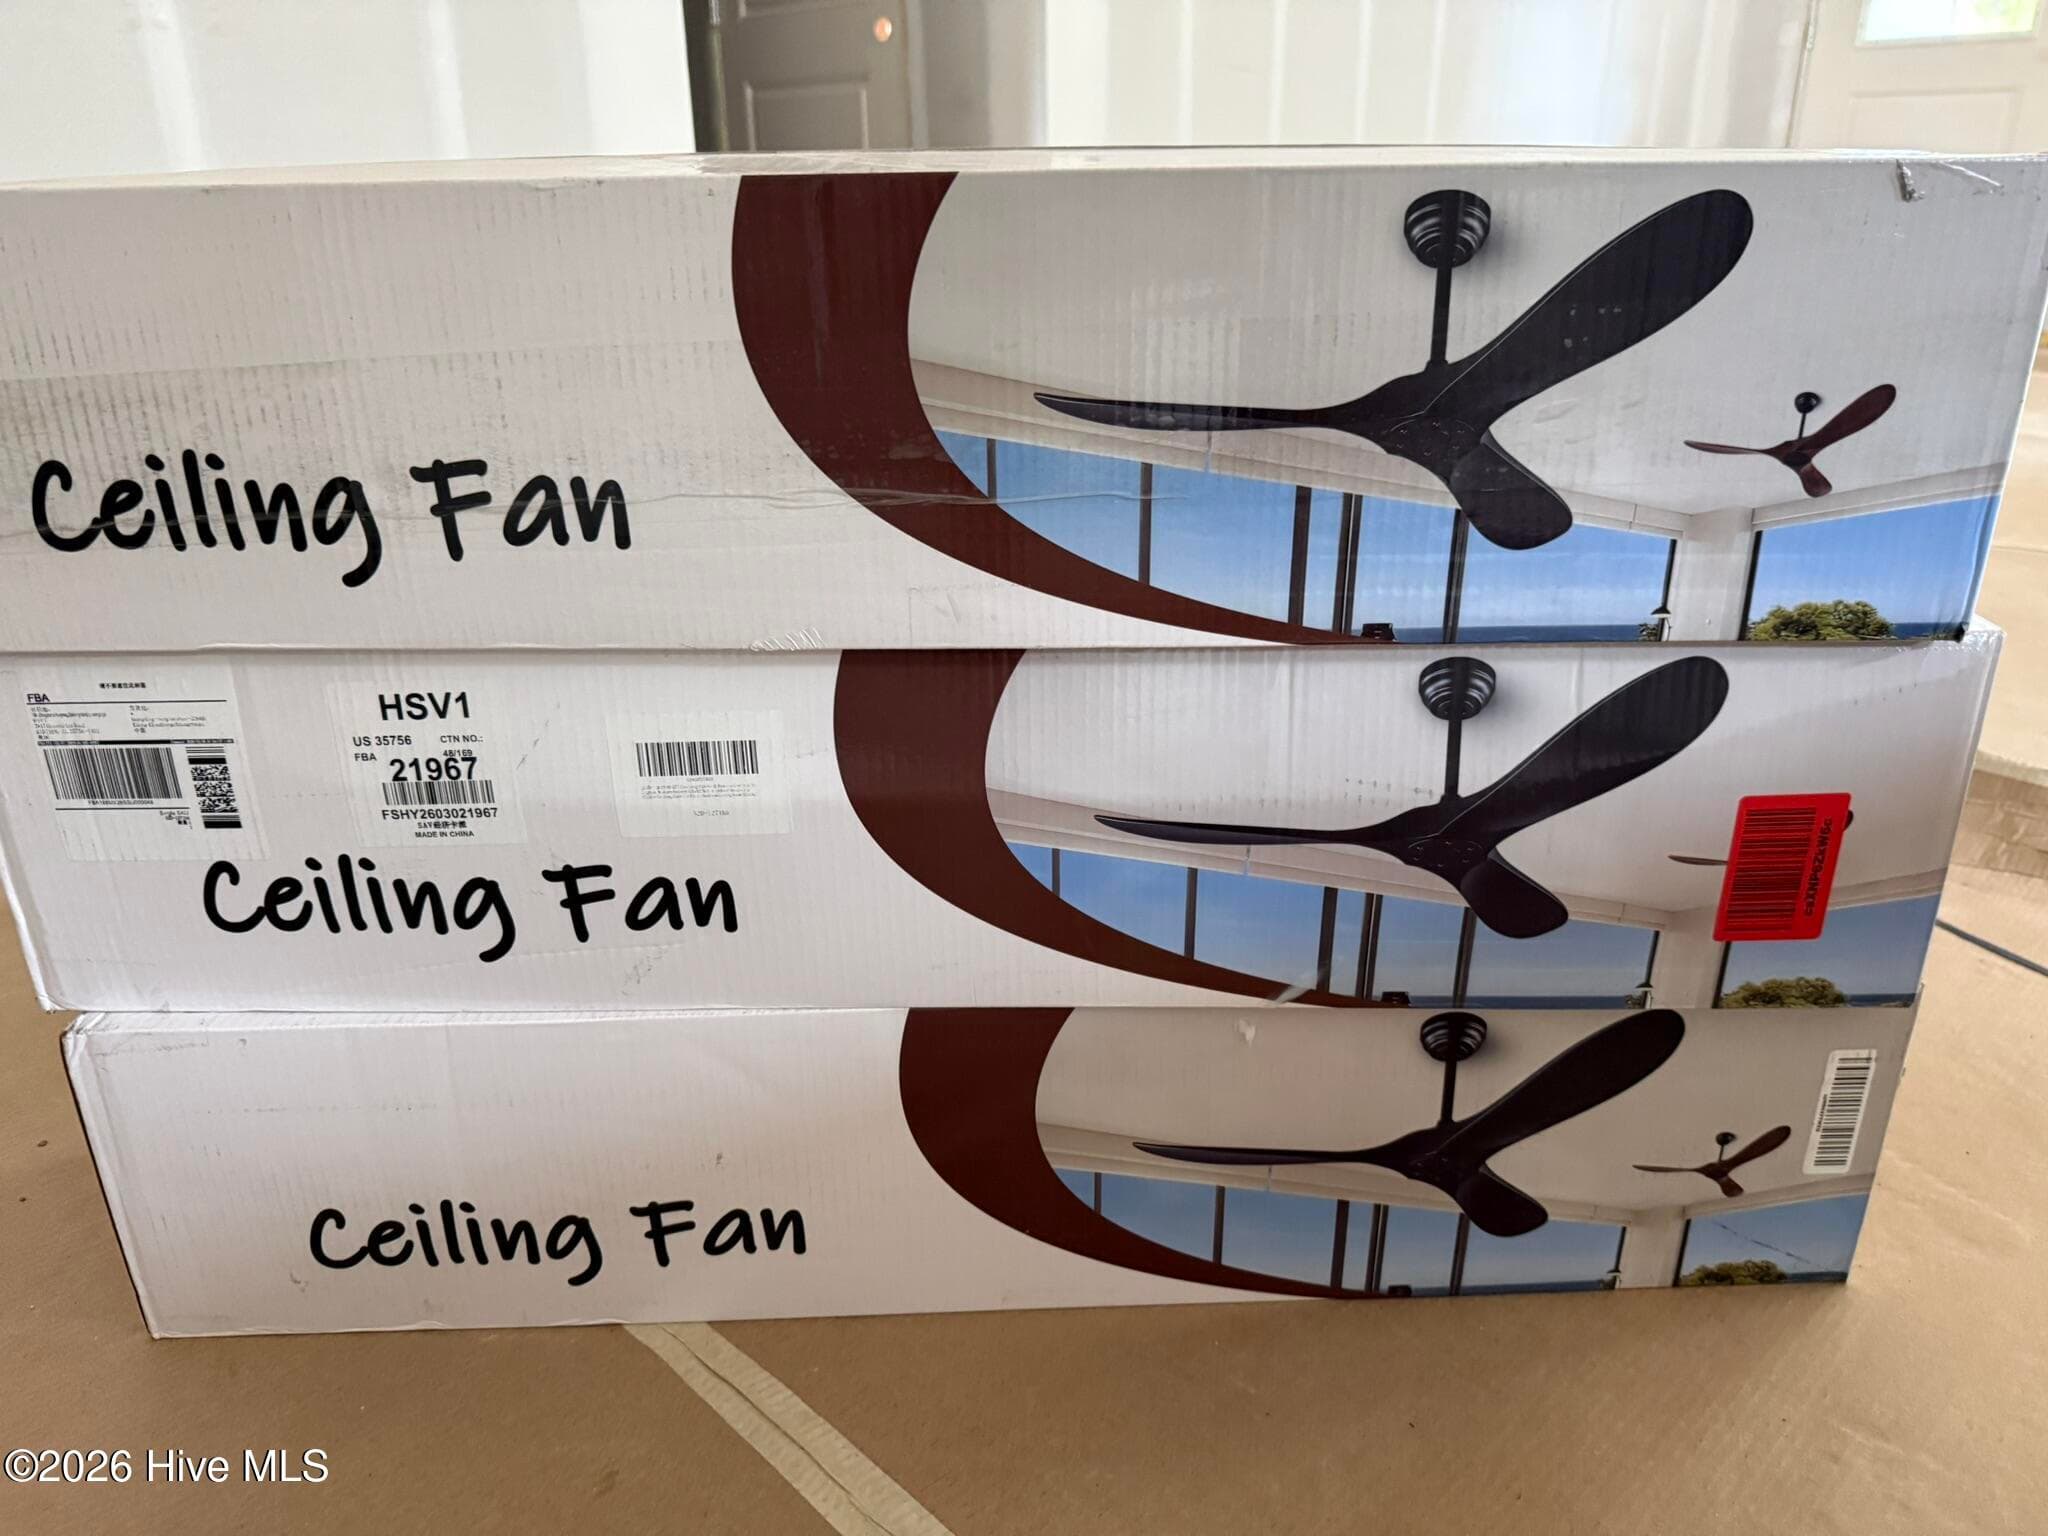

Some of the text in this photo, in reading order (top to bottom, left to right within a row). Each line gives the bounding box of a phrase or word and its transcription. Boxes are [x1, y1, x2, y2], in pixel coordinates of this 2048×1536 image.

[31, 448, 632, 588] Ceiling Fan
[26, 693, 50, 703] FBA
[378, 691, 470, 721] HSV1
[352, 735, 412, 747] US 35756
[440, 735, 460, 744] CTN
[354, 752, 377, 762] FBA
[389, 756, 478, 782] 21967
[381, 807, 498, 820] FSHY2603021967
[449, 830, 474, 838] CHINA
[202, 853, 738, 963] Ceiling Fan
[309, 1199, 807, 1286] Ceiling Fan
